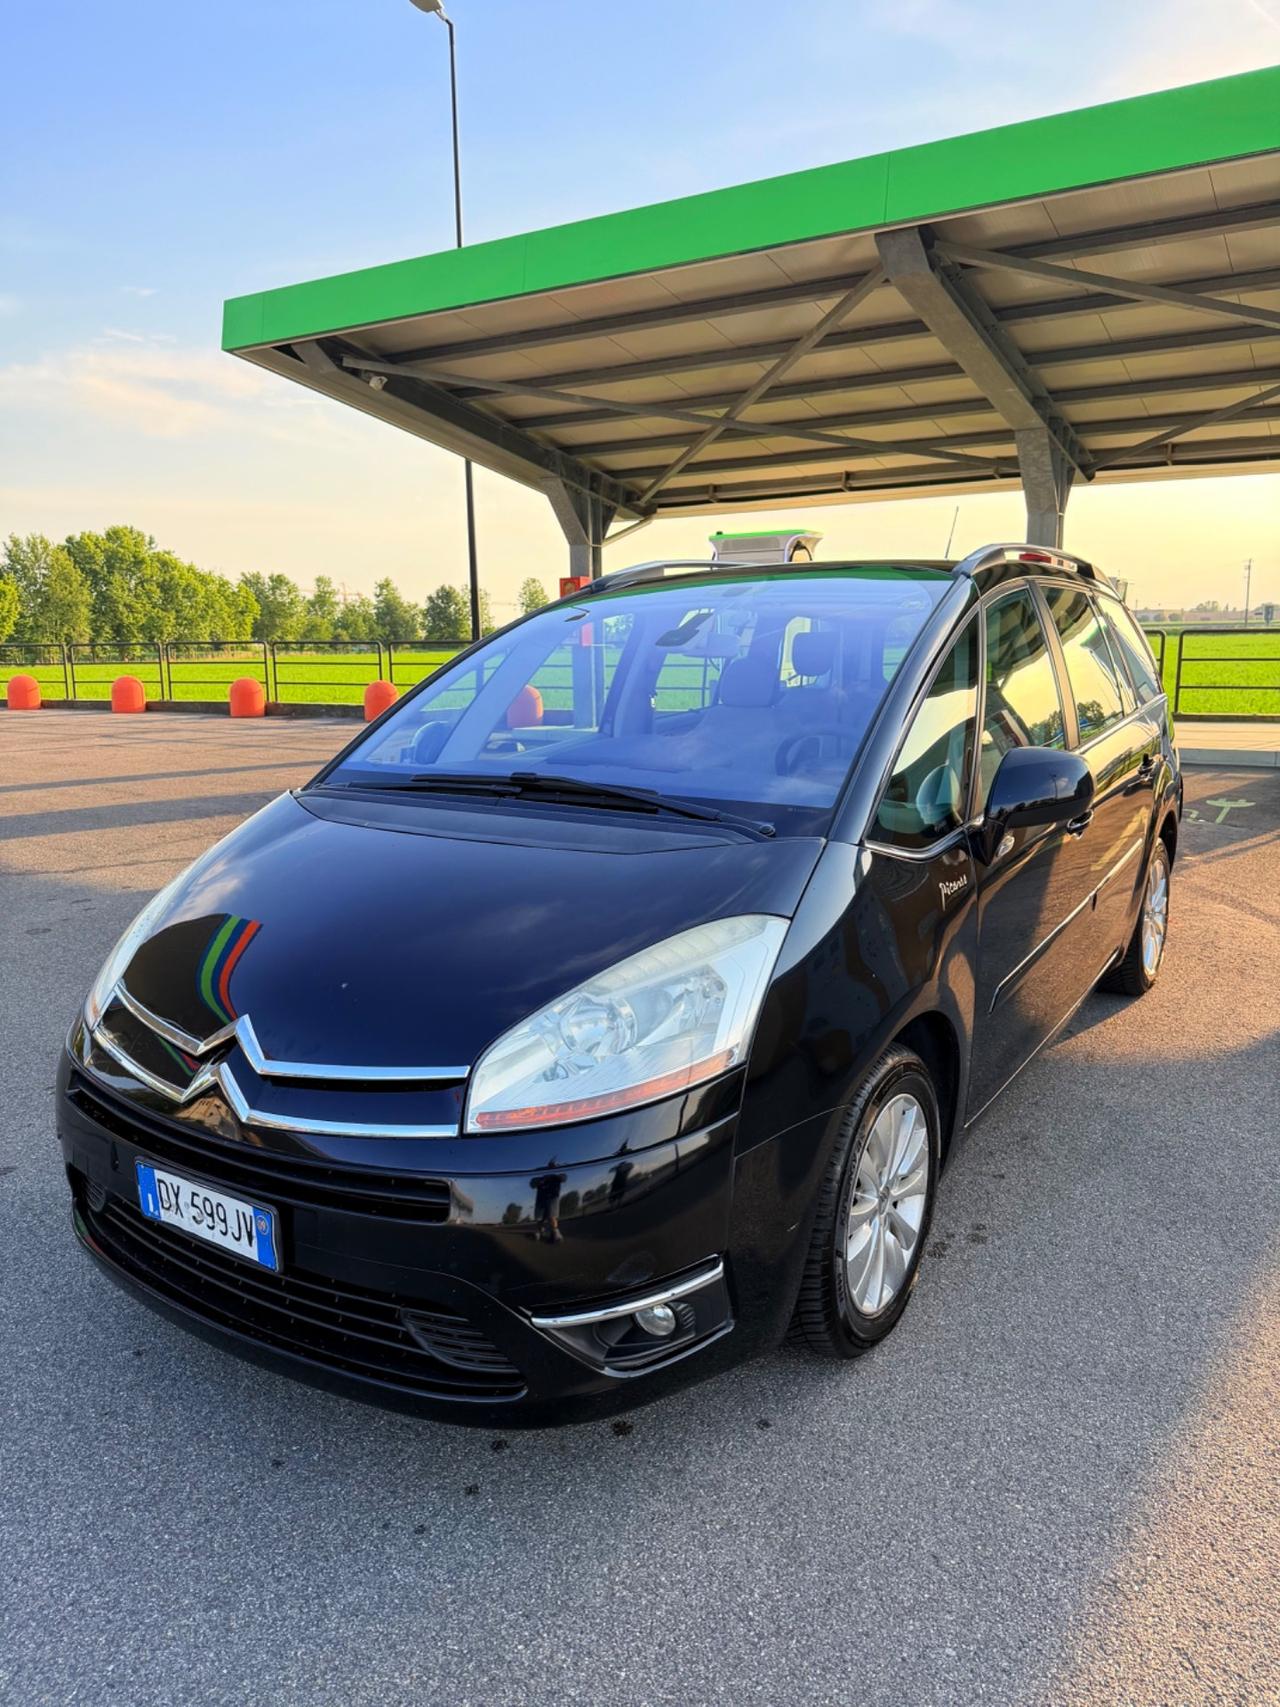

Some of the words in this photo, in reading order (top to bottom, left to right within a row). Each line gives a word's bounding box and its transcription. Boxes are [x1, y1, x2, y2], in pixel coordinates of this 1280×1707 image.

[156, 1177, 184, 1218] DX
[190, 1191, 229, 1237] 599
[231, 1208, 255, 1248] JV
